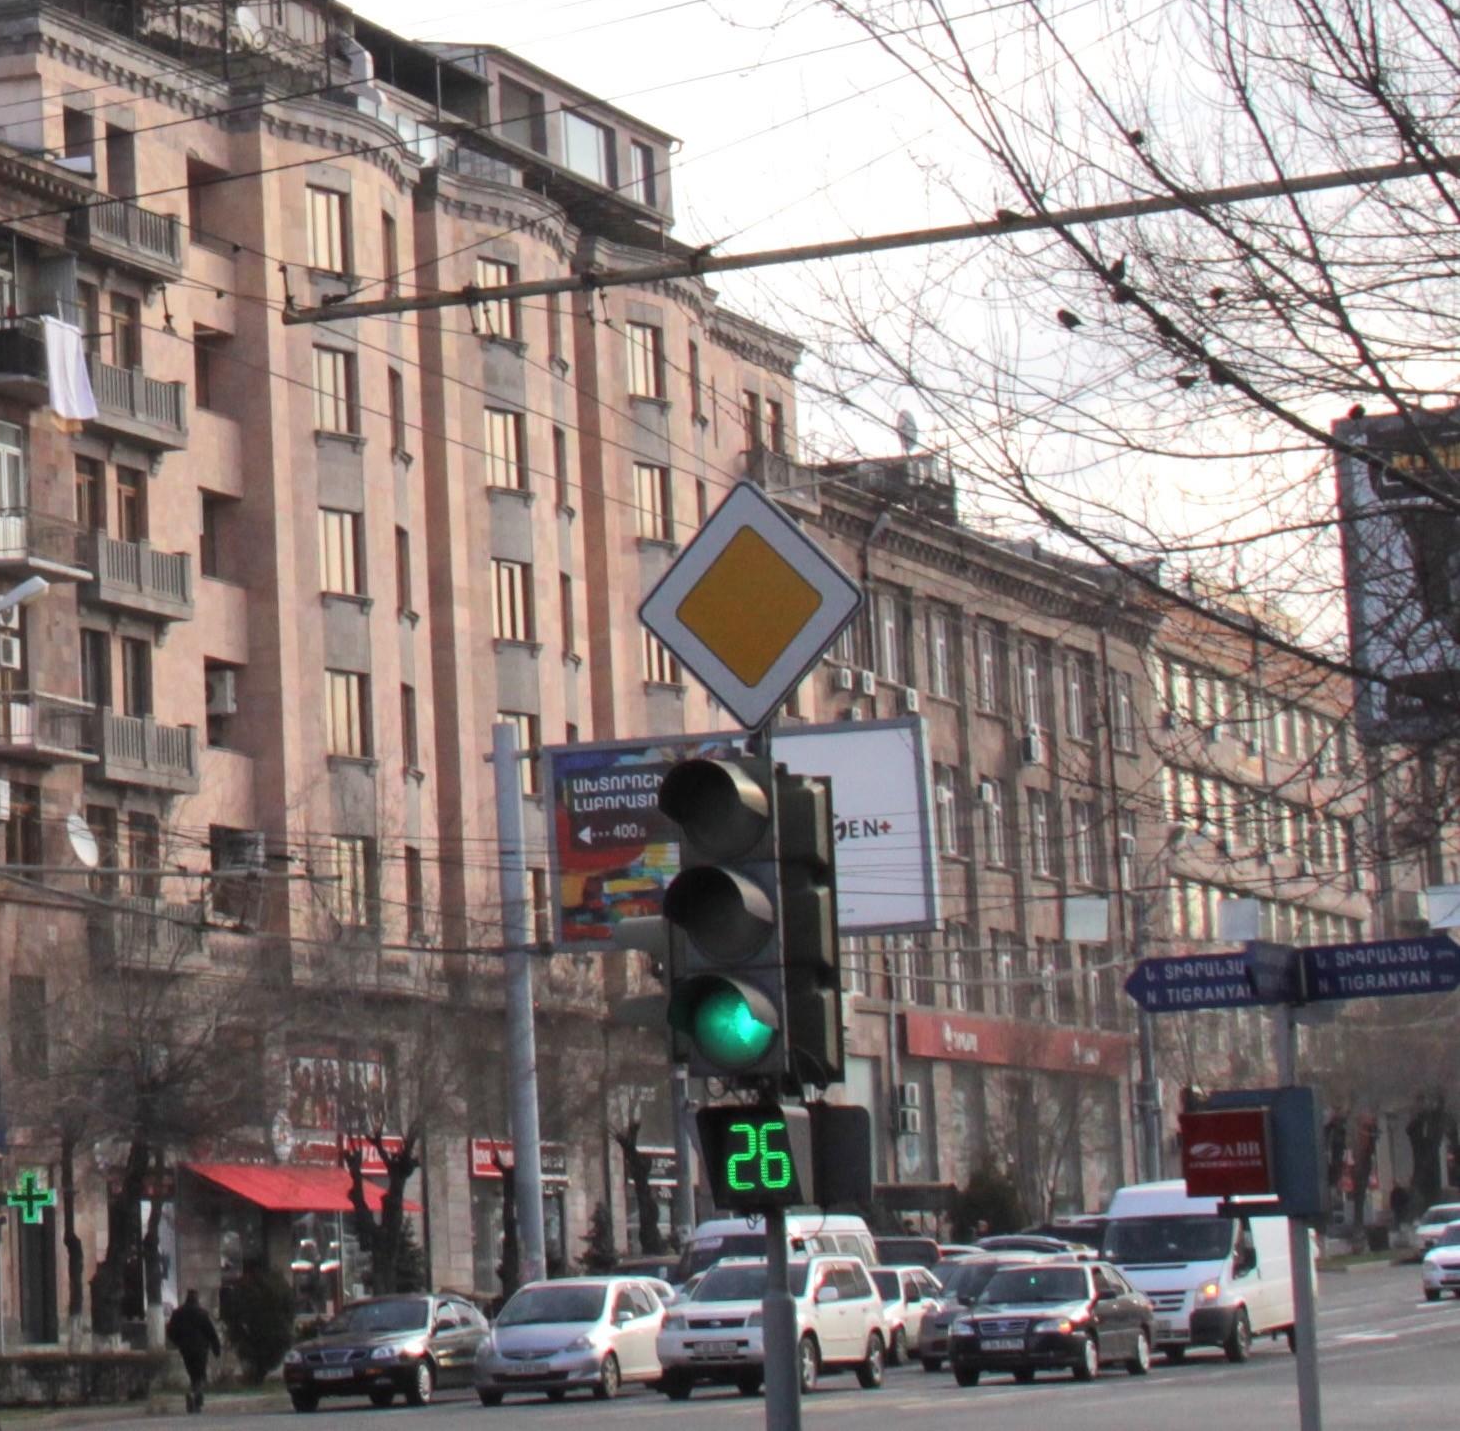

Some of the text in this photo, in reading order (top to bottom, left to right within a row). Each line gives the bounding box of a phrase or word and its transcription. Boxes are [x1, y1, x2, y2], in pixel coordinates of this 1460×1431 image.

[572, 772, 664, 794] ԱԽՏՈՐՈՇԻ
[574, 792, 659, 813] ԼԱԲՈՐԱՏՈ
[612, 822, 638, 839] 400
[1165, 960, 1245, 981] ՏԻԳՐԱՆՅԱ
[1338, 971, 1432, 992] TIGRANYAN
[727, 1122, 791, 1191] 26
